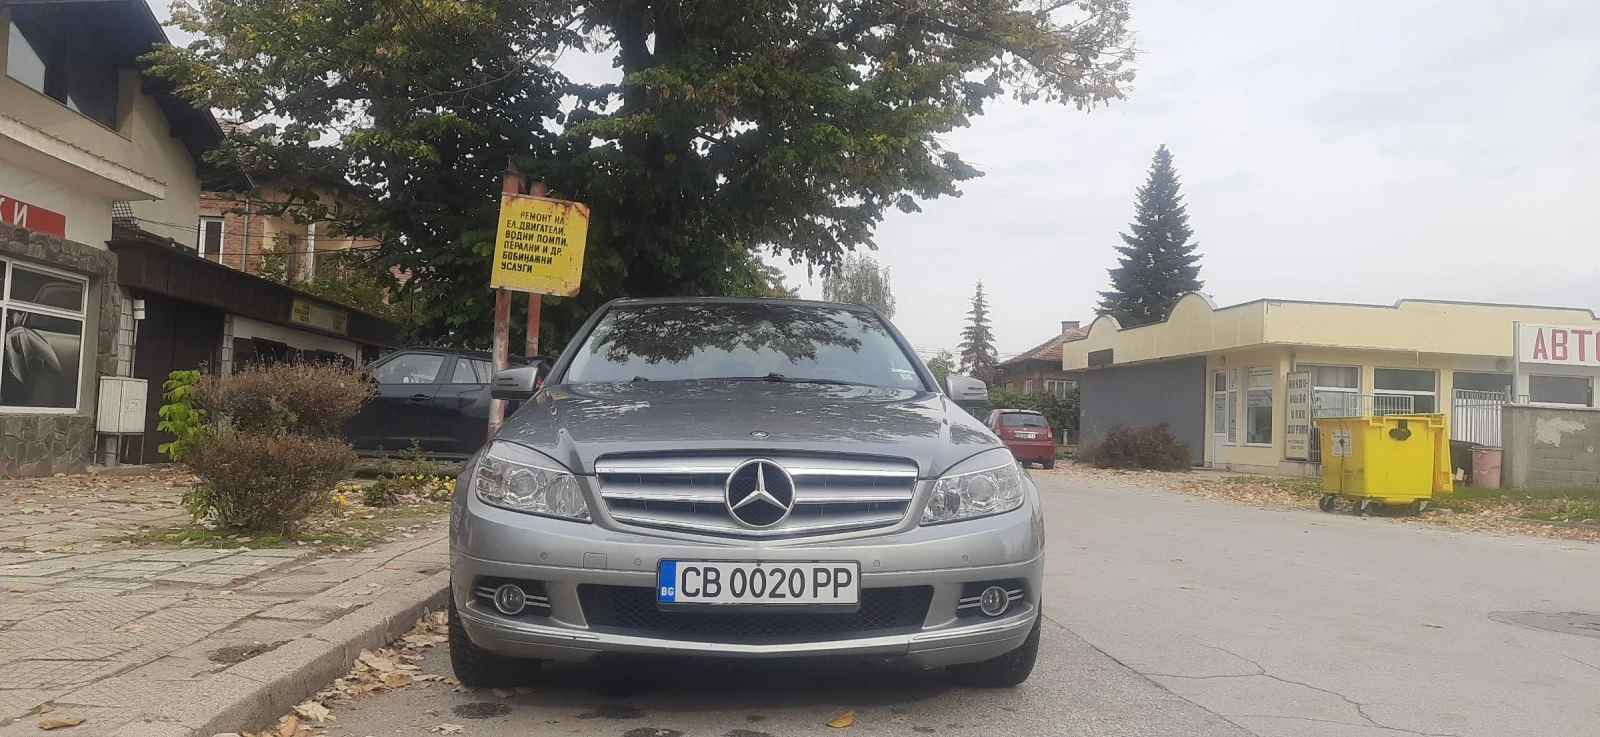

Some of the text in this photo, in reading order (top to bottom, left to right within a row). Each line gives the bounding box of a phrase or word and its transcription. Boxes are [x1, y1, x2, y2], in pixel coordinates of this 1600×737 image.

[521, 212, 552, 222] РЕМОНТ
[505, 229, 534, 242] ВОДНИ
[503, 240, 540, 252] ПЕРАЛНИ
[542, 245, 548, 254] И
[503, 251, 552, 265] БОБИНАЖНИ
[501, 262, 533, 273] УСЛУГИ
[1532, 327, 1600, 363] АВТ
[681, 566, 852, 599] CB 0020 PP
[660, 586, 675, 597] BG
